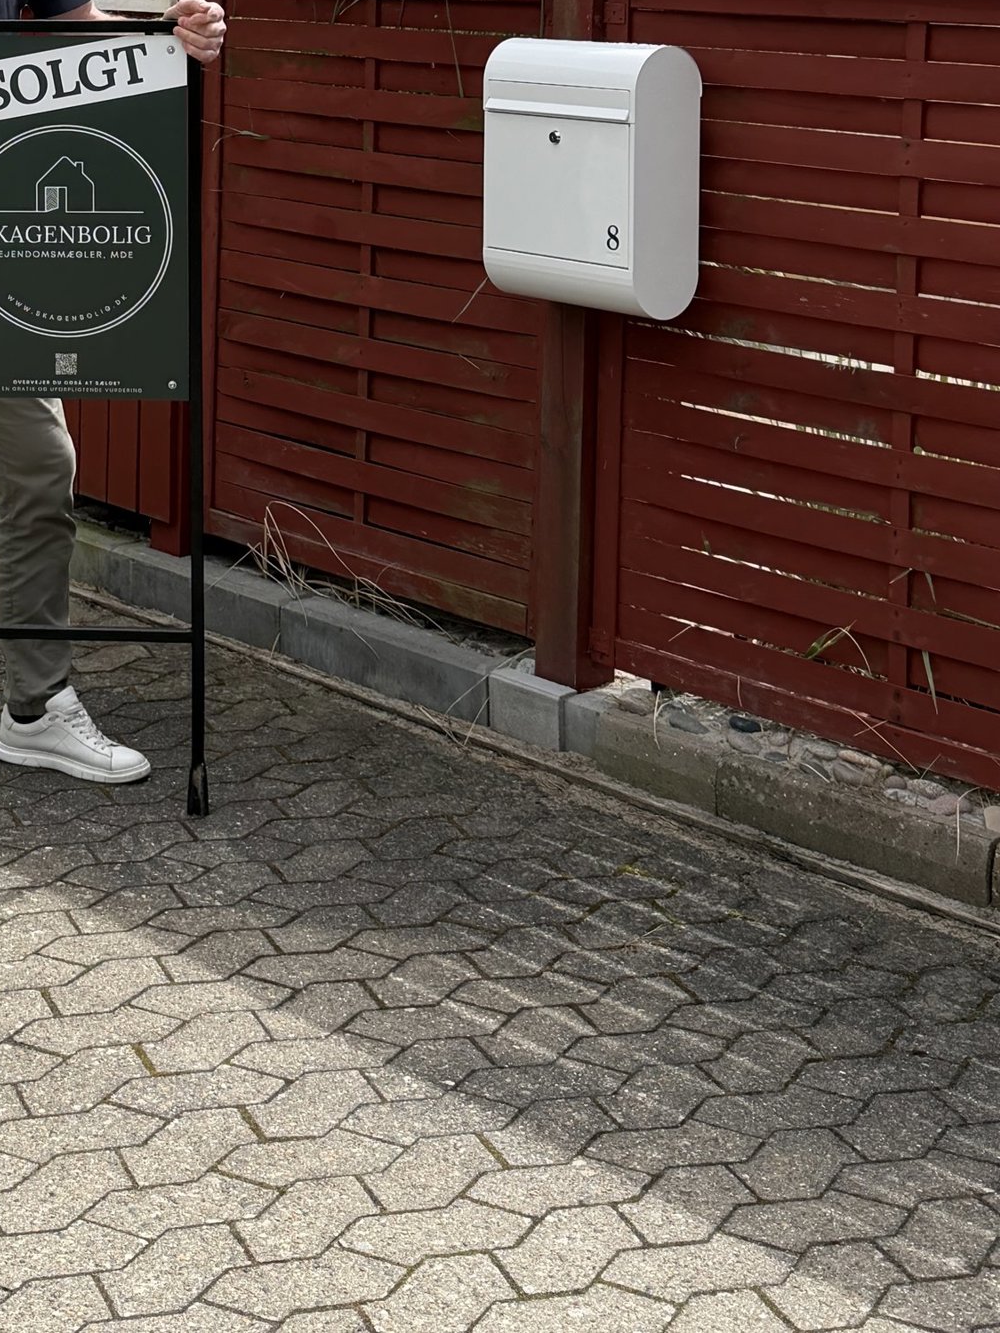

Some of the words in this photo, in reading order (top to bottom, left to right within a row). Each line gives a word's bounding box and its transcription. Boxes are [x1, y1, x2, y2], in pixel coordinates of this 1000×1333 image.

[606, 224, 620, 251] 8
[110, 250, 134, 259] MDE
[7, 294, 128, 322] WWW.SKAGENBOLIG.DK
